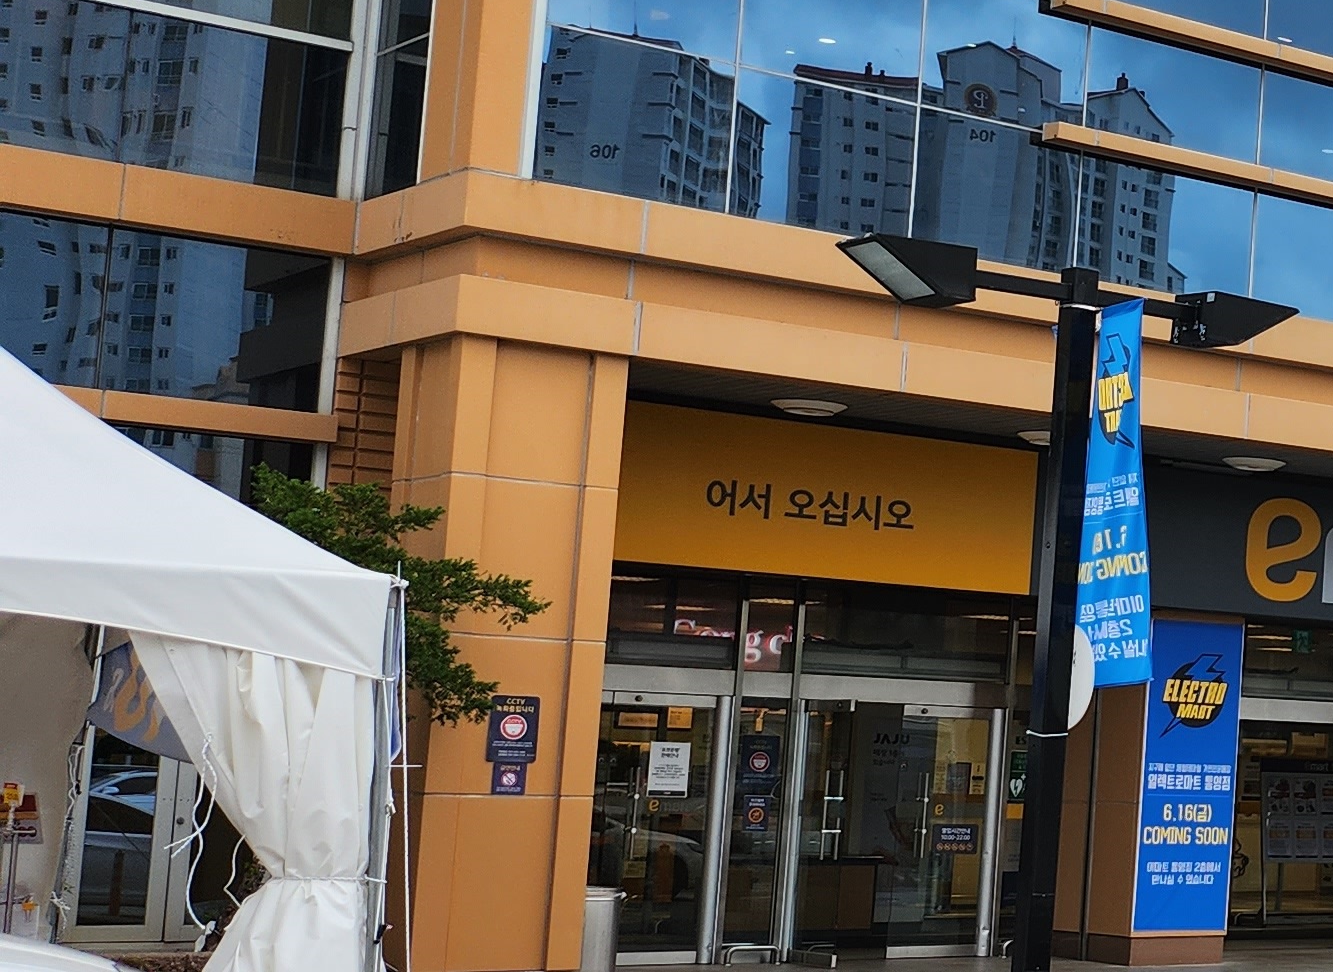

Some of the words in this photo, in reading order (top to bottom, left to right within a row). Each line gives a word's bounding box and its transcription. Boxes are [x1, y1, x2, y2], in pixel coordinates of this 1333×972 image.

[706, 479, 772, 520] 어서
[783, 489, 915, 531] 오십시오
[506, 697, 527, 705] CCTV
[1163, 678, 1228, 705] ELECTRO
[1175, 703, 1216, 720] MART
[1163, 803, 1213, 823] 6.16(금)
[1143, 826, 1192, 845] COMING
[1195, 826, 1228, 846] SOON
